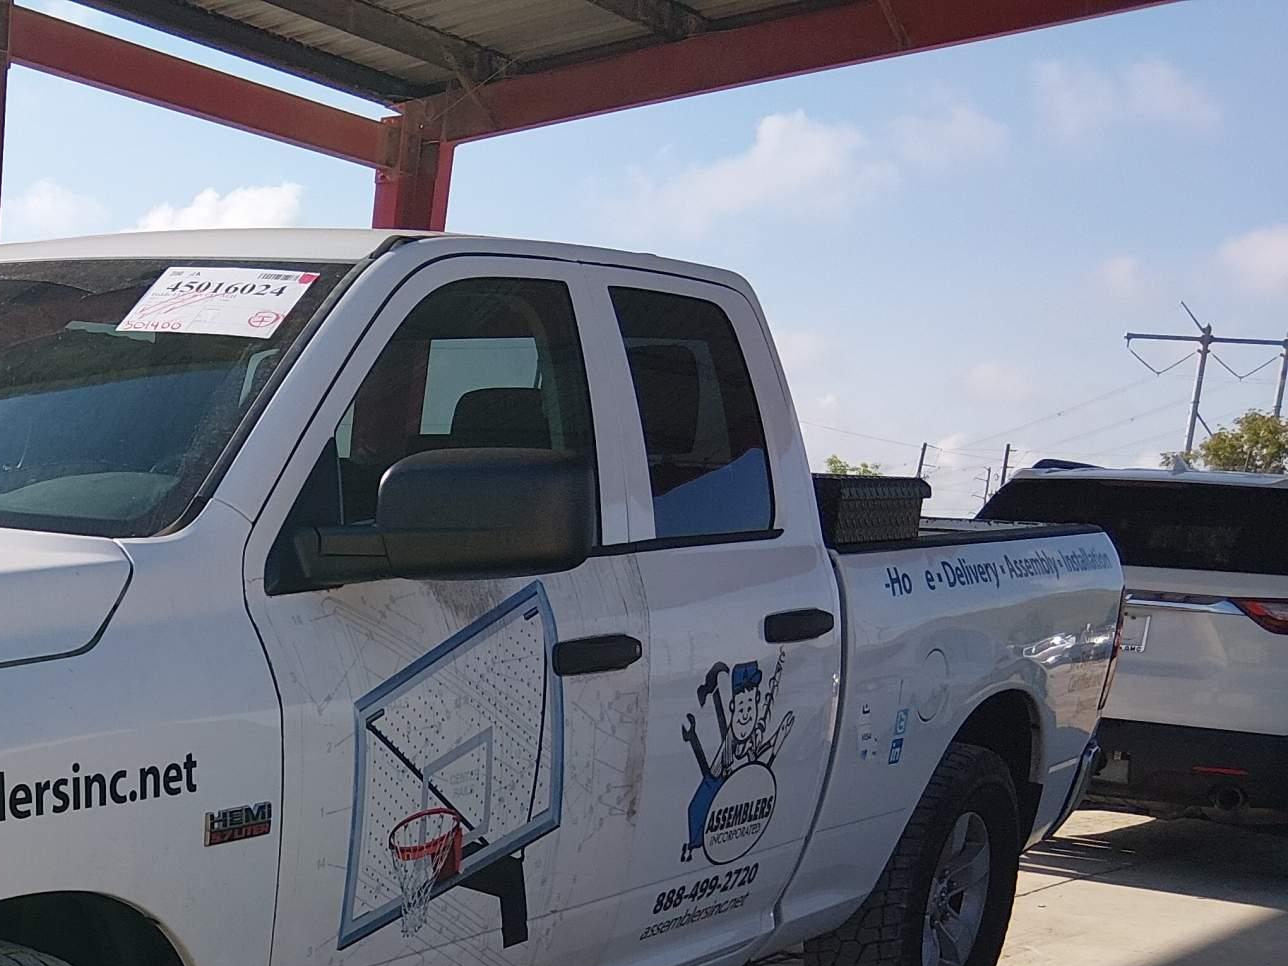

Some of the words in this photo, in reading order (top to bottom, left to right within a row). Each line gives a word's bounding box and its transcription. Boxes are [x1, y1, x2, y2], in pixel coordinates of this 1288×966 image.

[166, 280, 288, 297] 45016024
[940, 556, 1000, 588] Delivery
[1004, 548, 1062, 580] Assembly
[1064, 546, 1110, 571] Installation
[205, 801, 272, 831] HEMI
[705, 795, 774, 834] ASSEMBLERS
[708, 822, 762, 847] INCORPORATED
[652, 862, 760, 915] 888-499-2720
